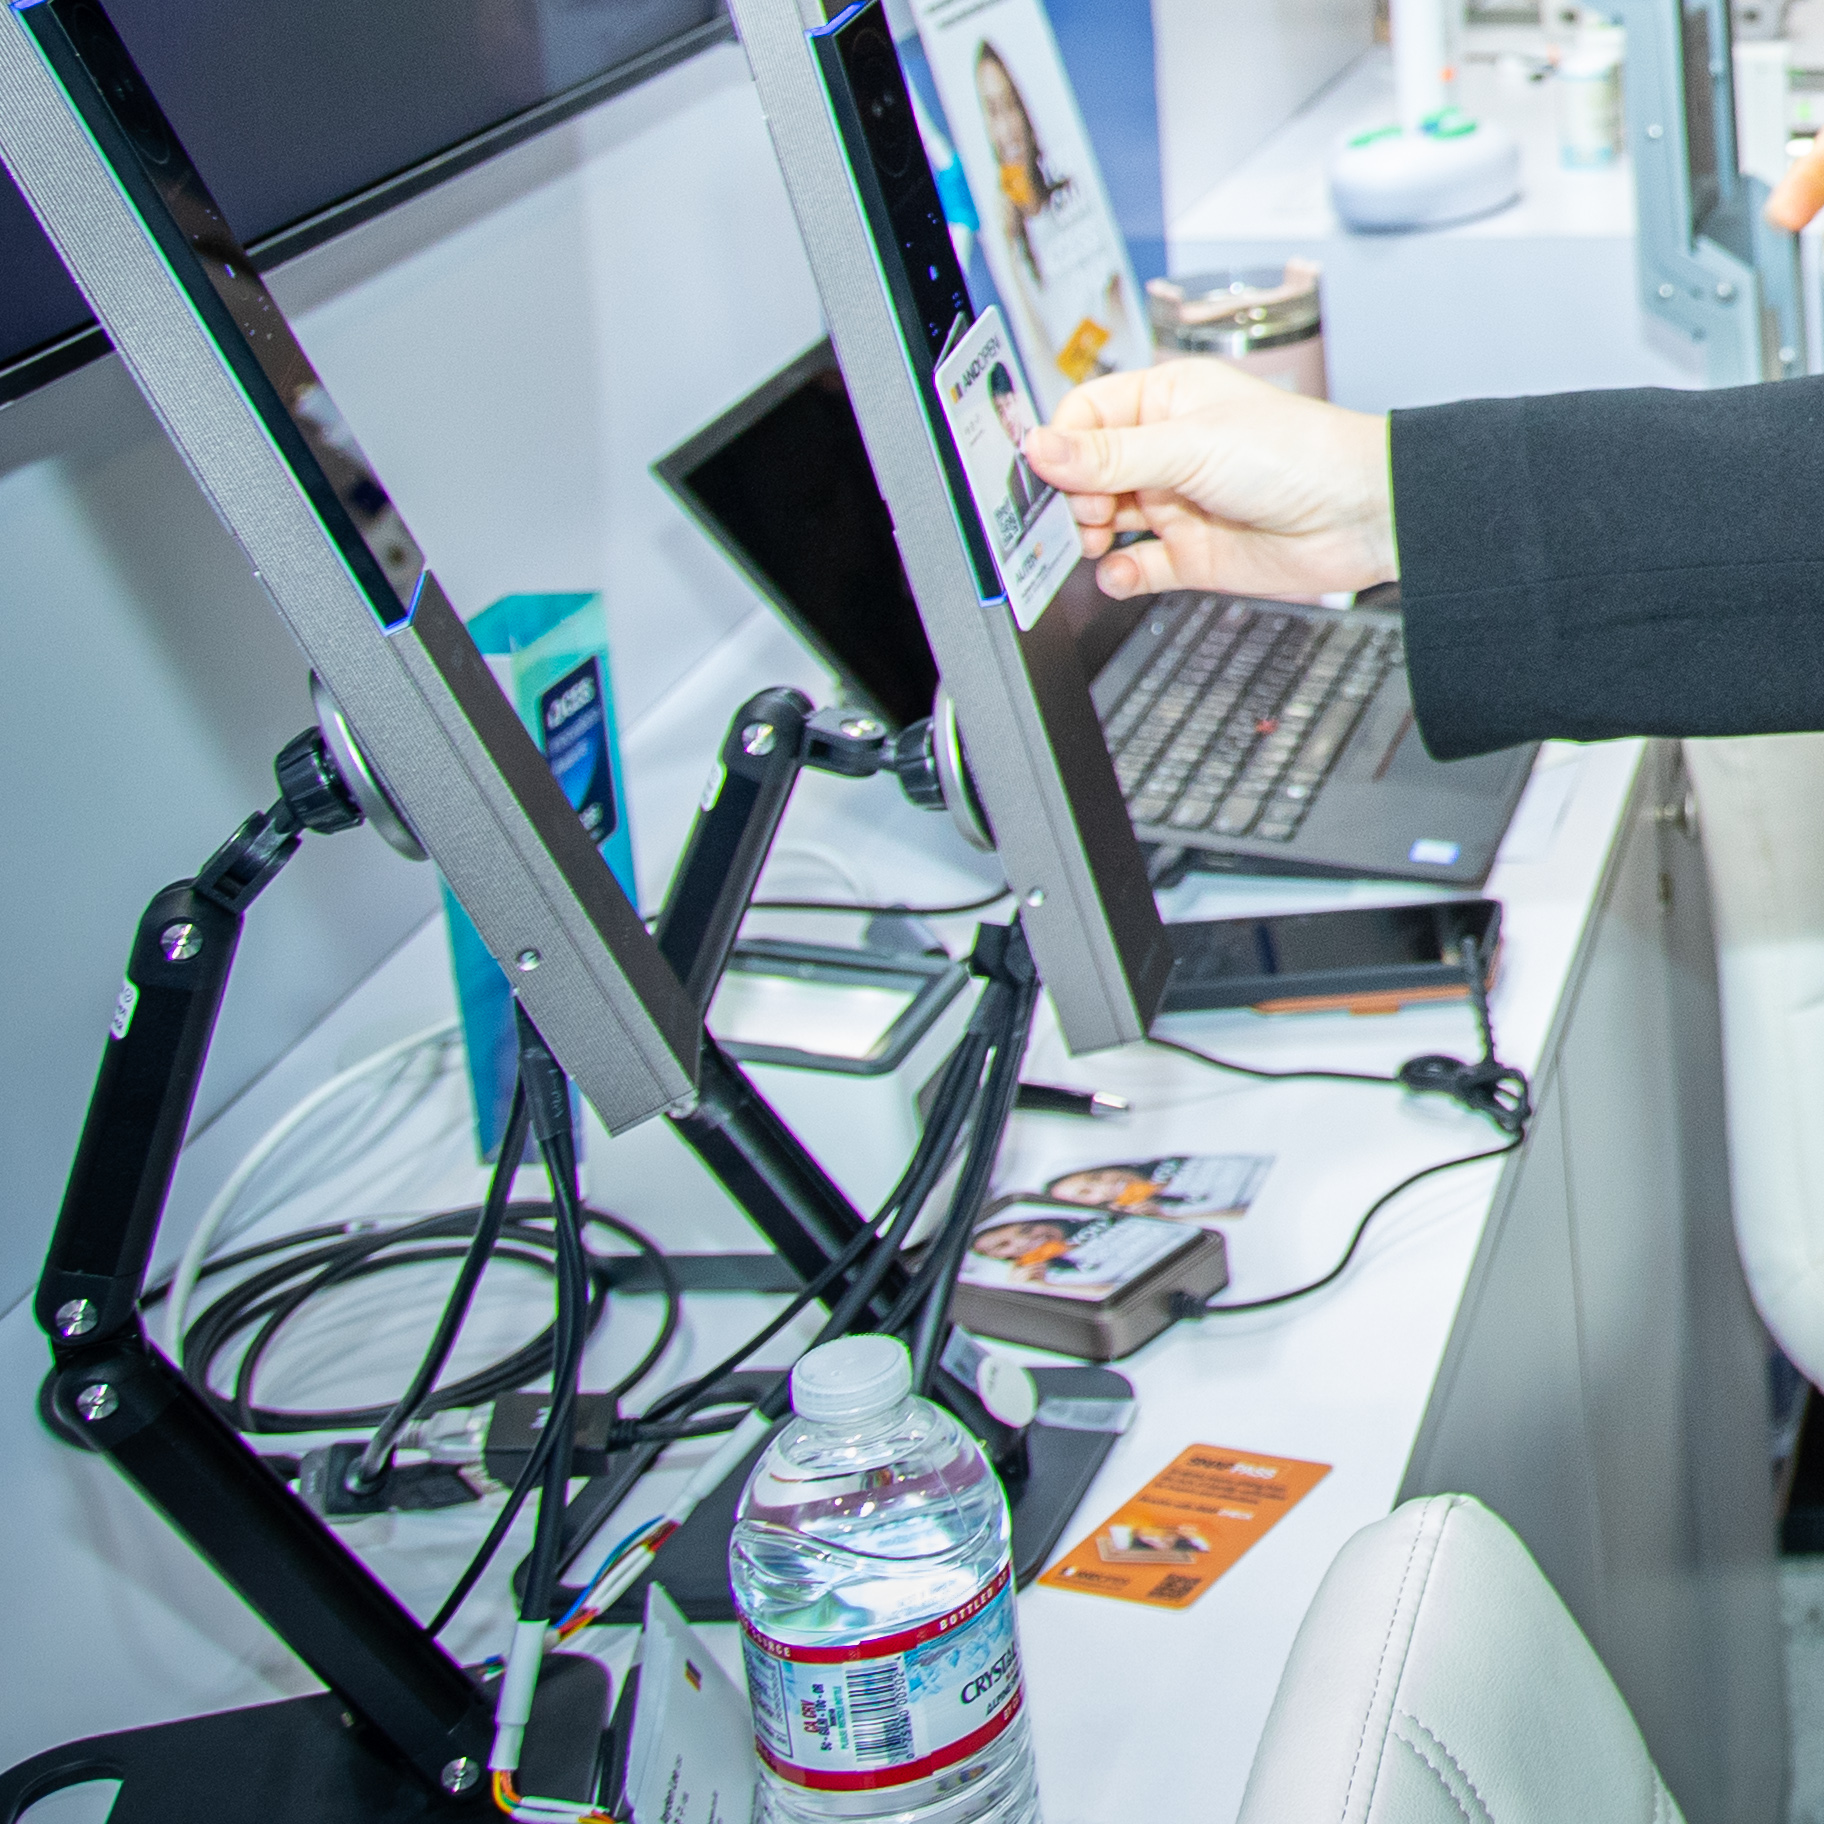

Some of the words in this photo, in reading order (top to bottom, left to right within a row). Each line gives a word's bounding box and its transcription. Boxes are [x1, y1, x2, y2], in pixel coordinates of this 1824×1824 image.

[939, 1586, 994, 1632] BOTTLED
[893, 1671, 909, 1706] 00502
[800, 1699, 817, 1719] CRV
[803, 1721, 819, 1733] CA
[906, 1752, 915, 1760] 0
